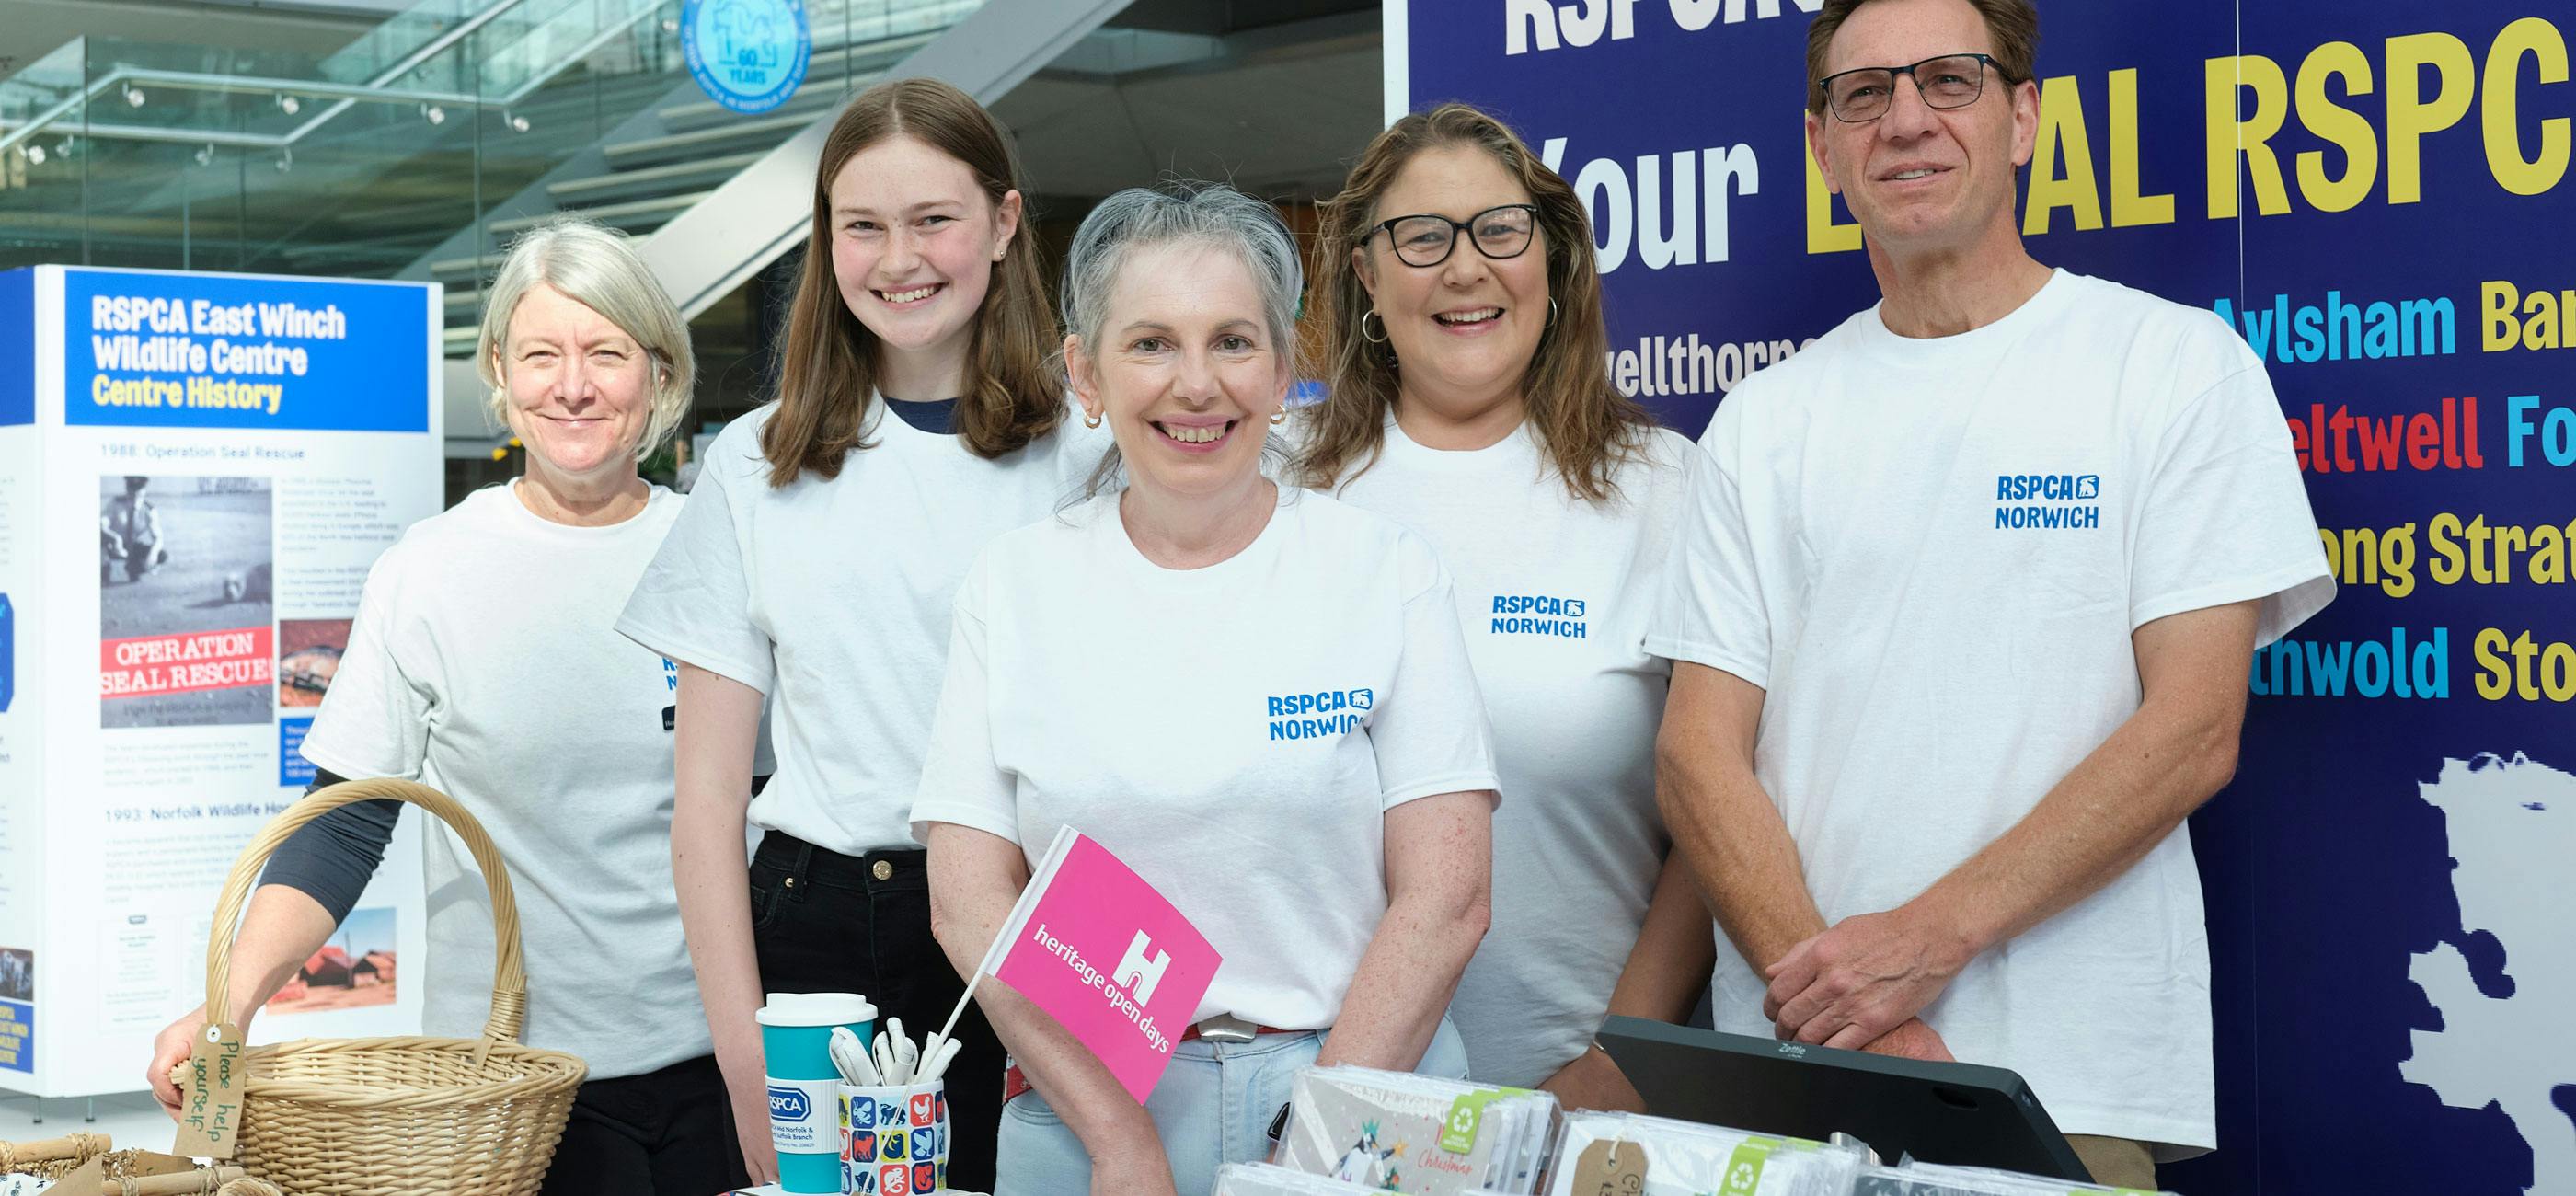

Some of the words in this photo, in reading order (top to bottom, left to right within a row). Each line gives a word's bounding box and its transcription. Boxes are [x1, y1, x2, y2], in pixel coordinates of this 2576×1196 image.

[1805, 68, 2175, 255] LAL
[93, 295, 188, 334] RSPCA
[192, 301, 255, 336] East
[259, 304, 346, 339] Winch
[93, 336, 207, 371] Wildlife
[211, 341, 308, 376] Centre
[93, 375, 183, 407] Centre
[188, 378, 282, 414] History
[145, 444, 216, 463] Operation
[222, 445, 250, 459] Seal
[256, 447, 305, 460] Rescue
[1997, 475, 2073, 500] RSPCA
[1995, 506, 2099, 529] NORWICH
[1492, 596, 1561, 615] RSPCA
[1491, 618, 1586, 638] NORWICH
[115, 632, 255, 666] OPERATION
[99, 668, 167, 696] SEAL
[1268, 691, 1347, 717] RSPCA
[151, 805, 202, 820] Norfolk
[208, 803, 260, 817] Wildlife
[1033, 924, 1105, 989] heritage
[1104, 983, 1141, 1023] open
[1139, 1017, 1169, 1053] days
[219, 1040, 240, 1089] Please
[184, 1056, 209, 1132] yourself
[207, 1104, 236, 1142] help
